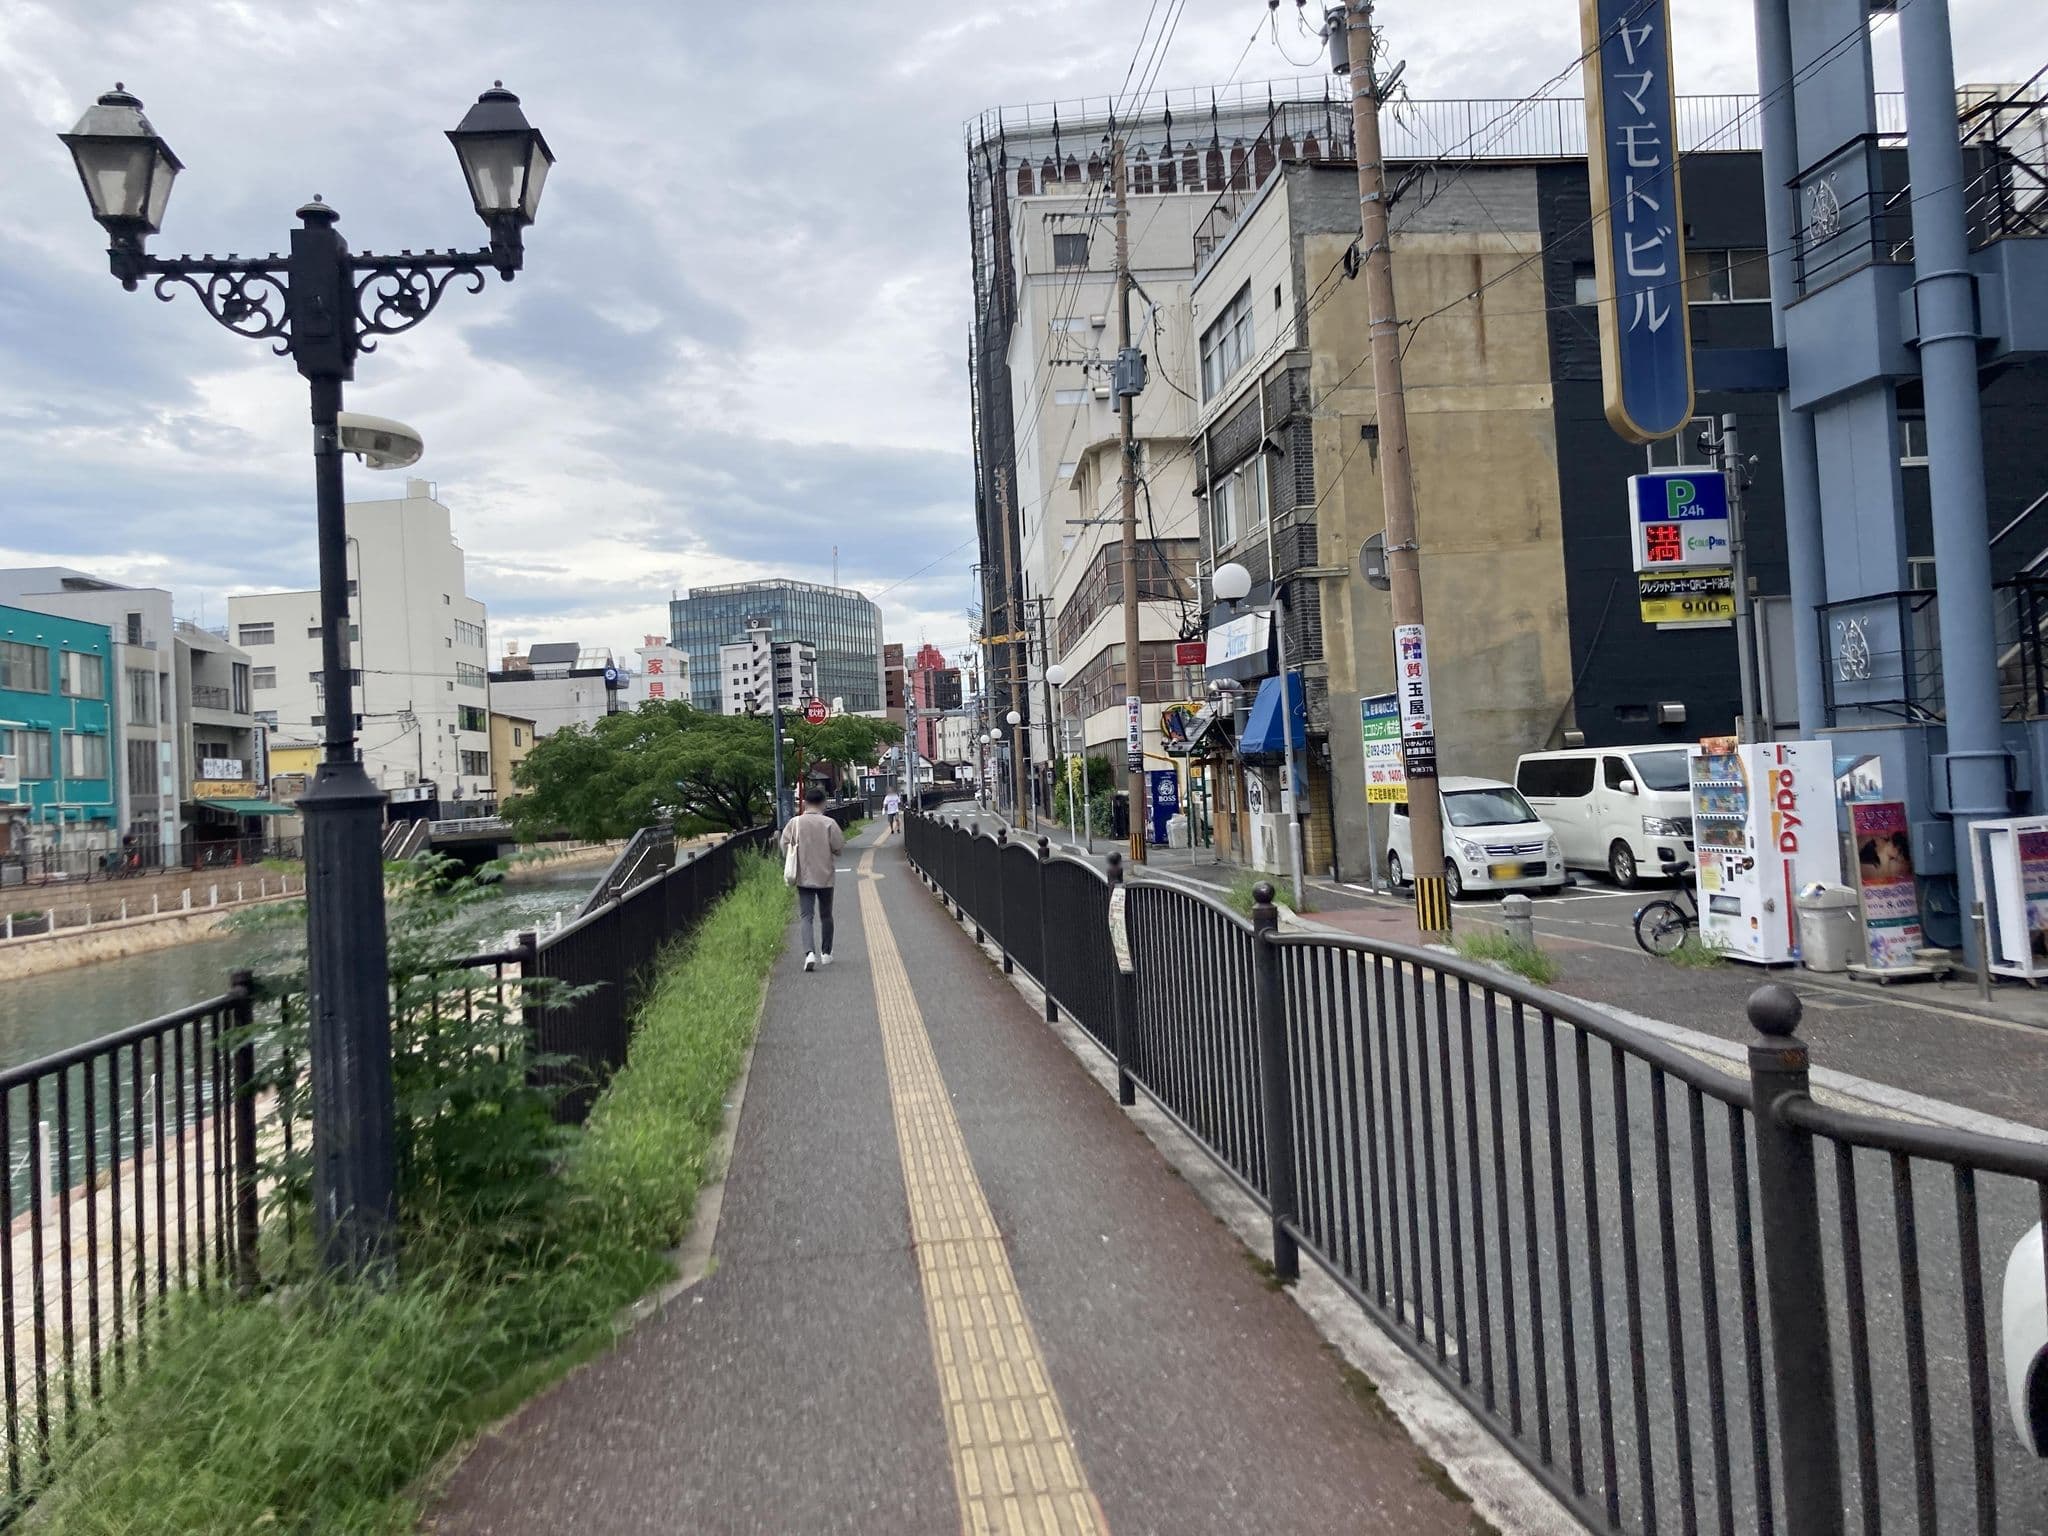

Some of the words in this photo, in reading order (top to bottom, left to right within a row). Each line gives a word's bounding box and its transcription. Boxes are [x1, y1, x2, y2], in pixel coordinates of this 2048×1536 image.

[1613, 17, 1672, 334] ヤマモトビル
[1666, 479, 1696, 518] P
[1680, 504, 1705, 517] 24h
[647, 658, 665, 699] 家具
[1158, 794, 1176, 802] BOSS
[1776, 769, 1801, 854] DyDo
